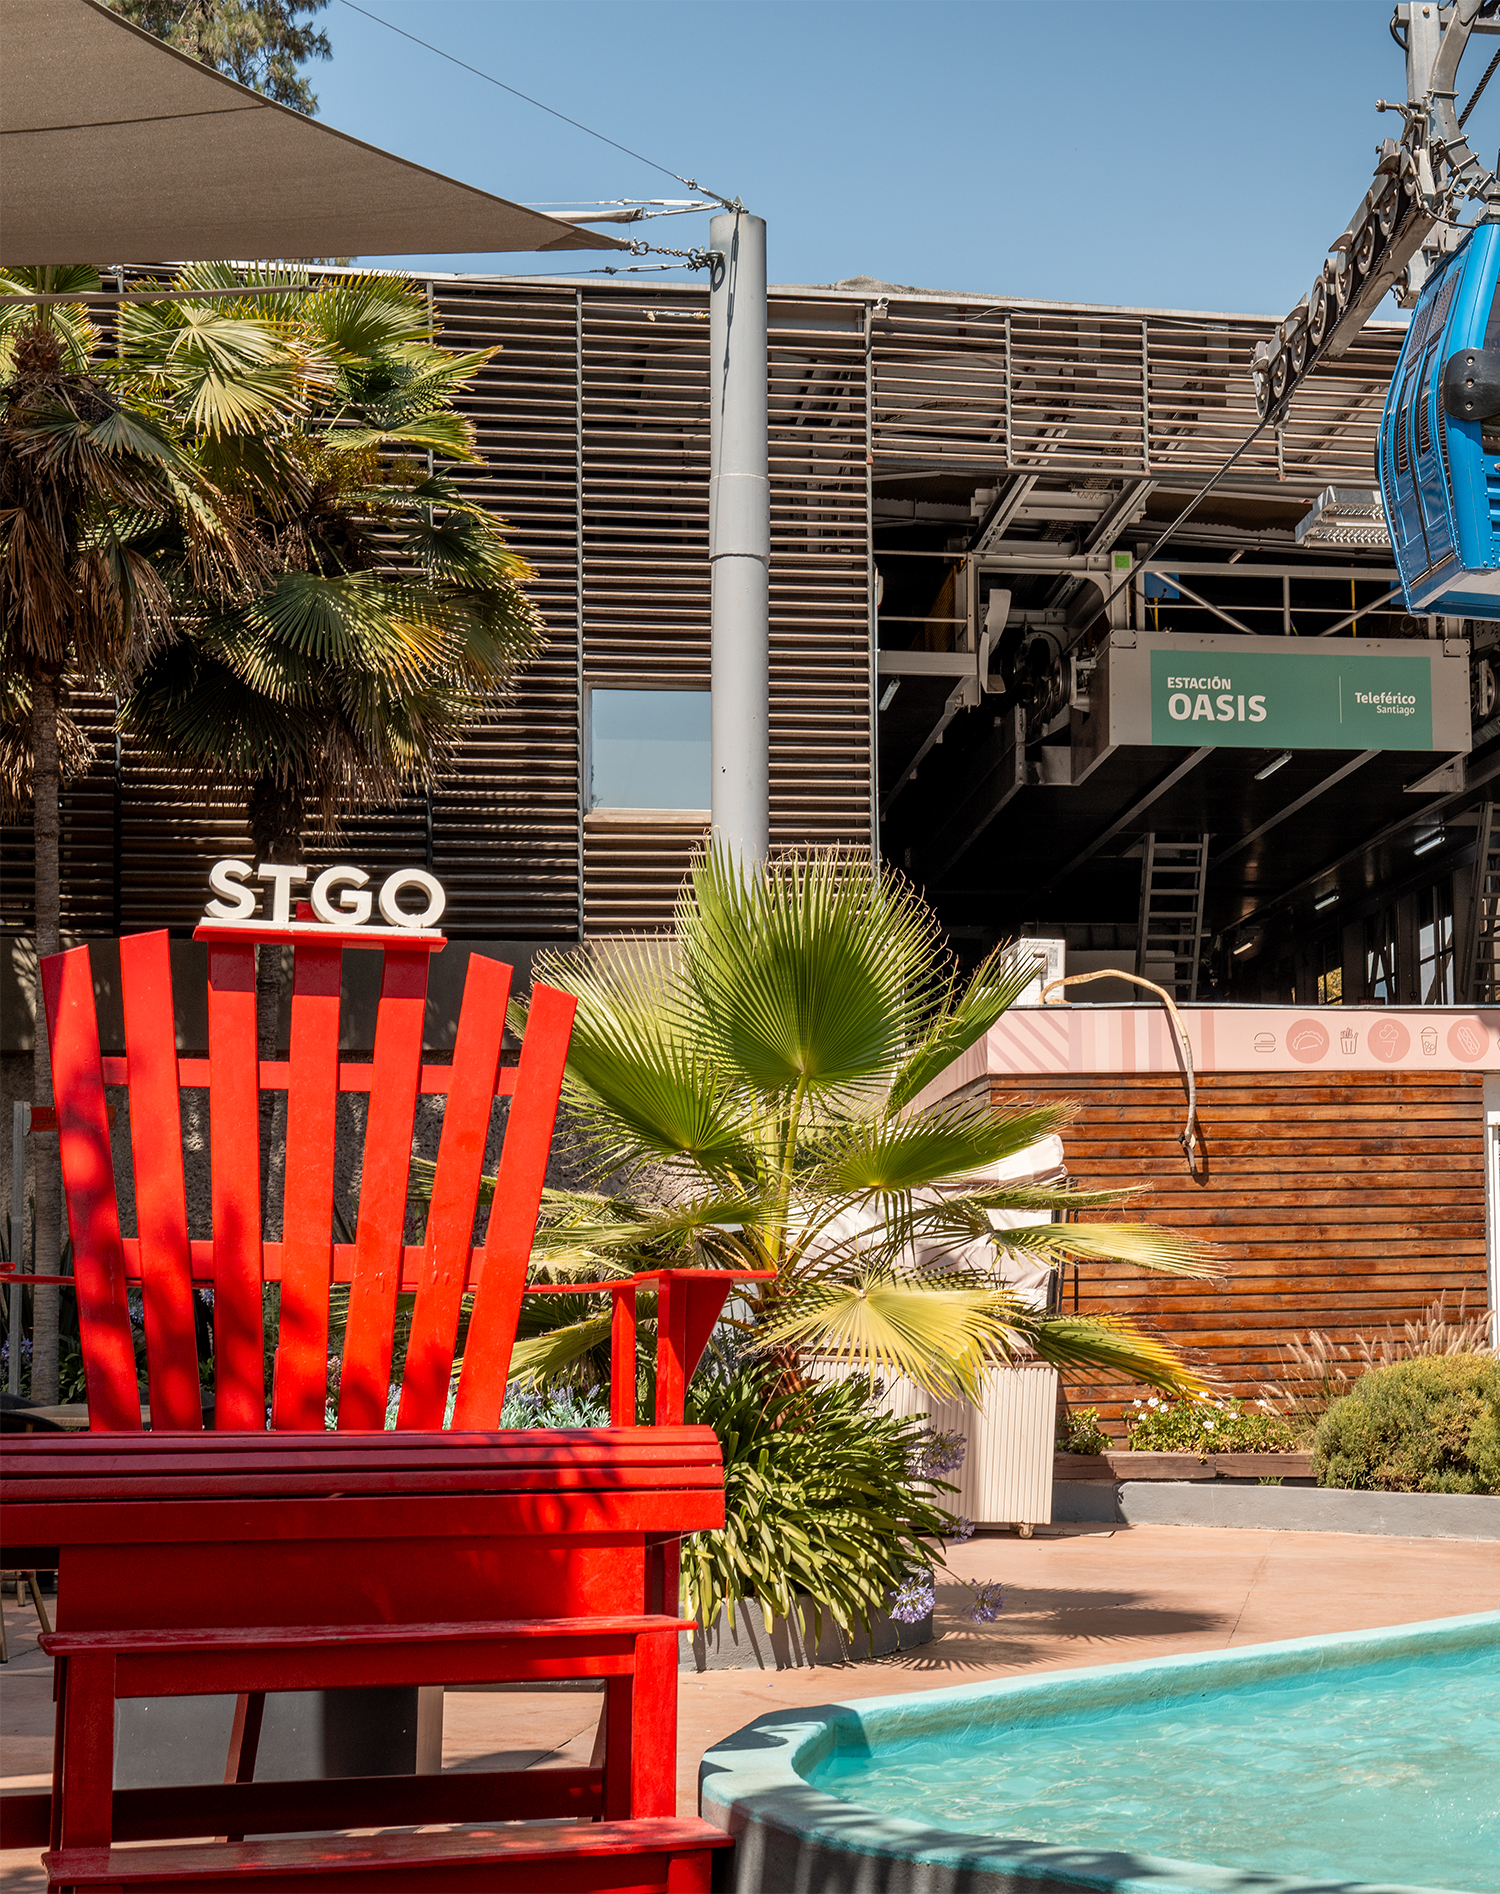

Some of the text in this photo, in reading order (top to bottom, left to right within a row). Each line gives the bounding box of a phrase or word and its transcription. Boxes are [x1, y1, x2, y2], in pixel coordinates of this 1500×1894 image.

[1167, 676, 1231, 690] ESTACIÓN
[1355, 692, 1416, 706] Teleférico
[1168, 692, 1267, 722] OASIS
[1376, 704, 1415, 717] Santiago
[205, 860, 446, 928] STGO
